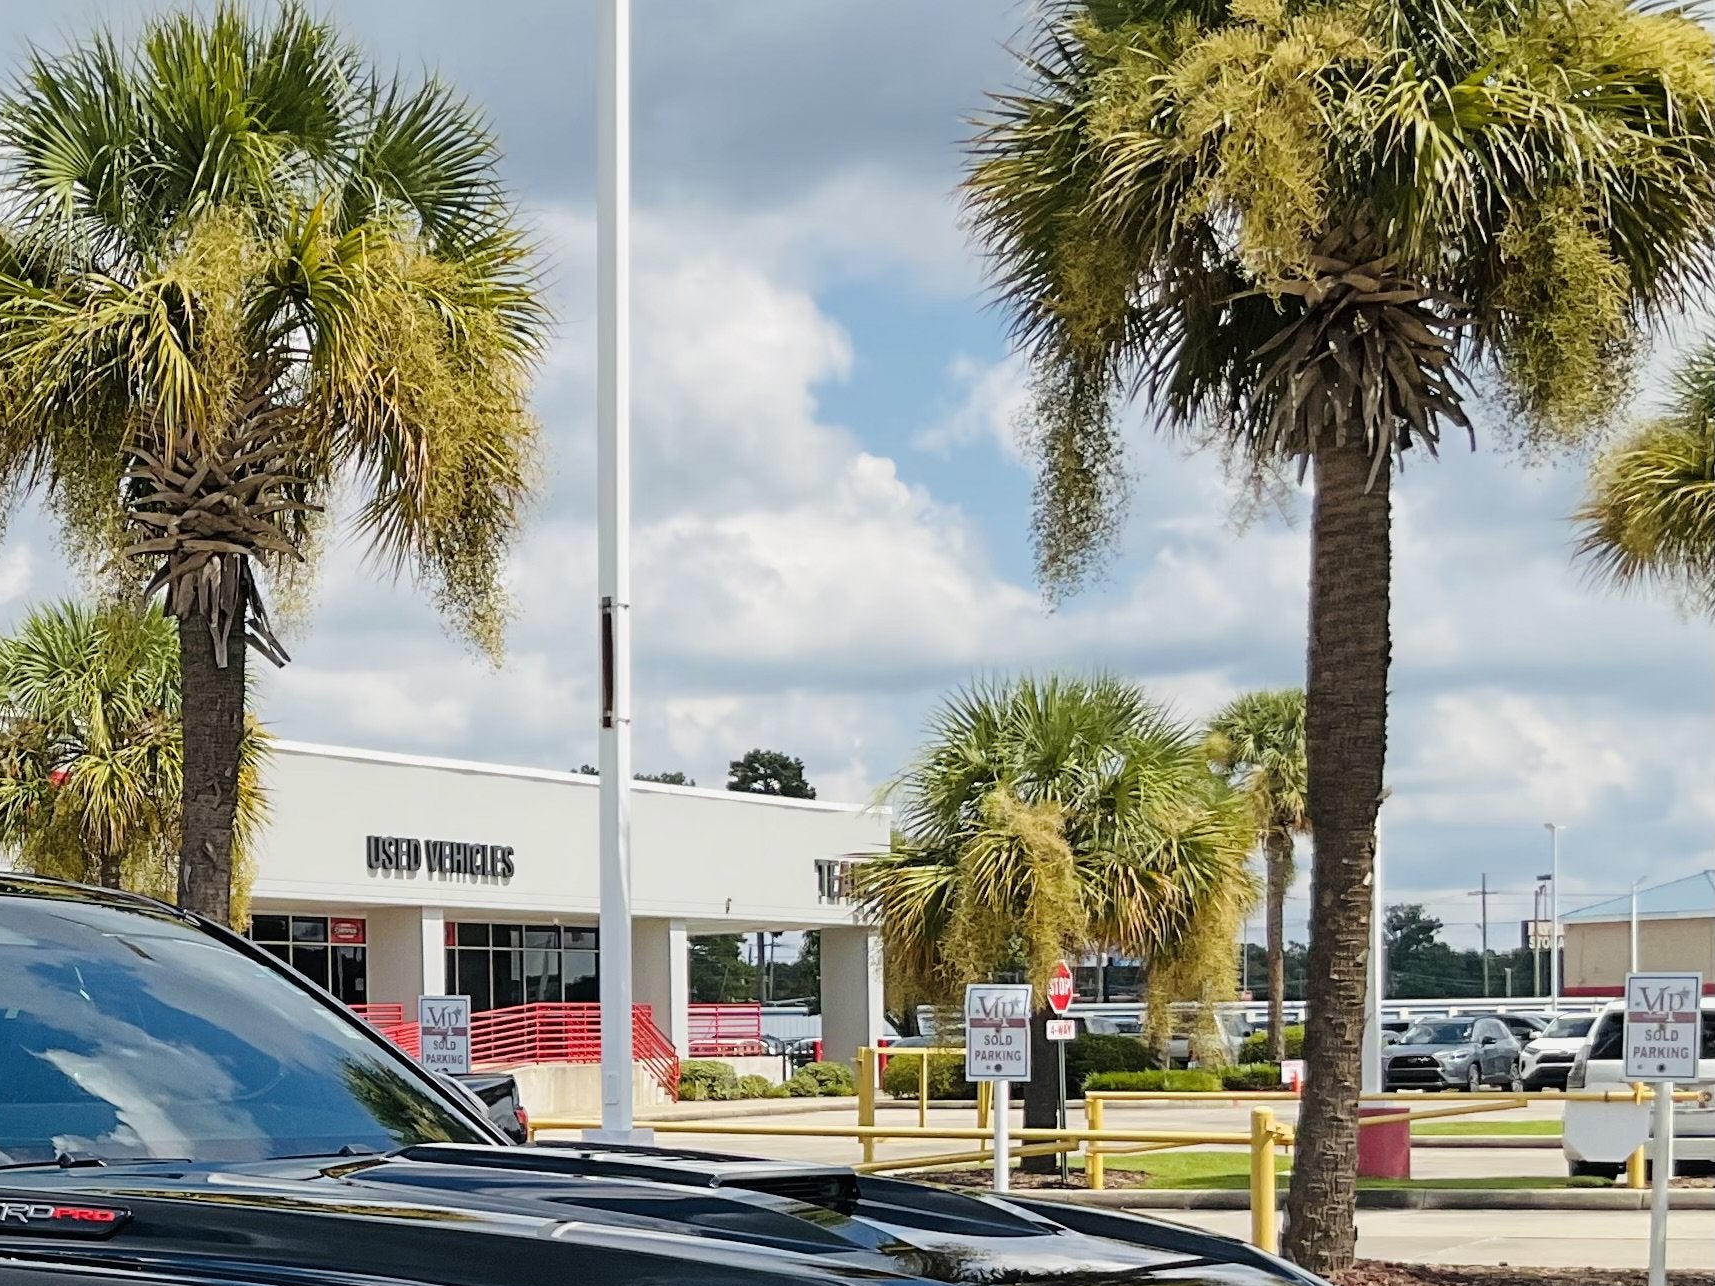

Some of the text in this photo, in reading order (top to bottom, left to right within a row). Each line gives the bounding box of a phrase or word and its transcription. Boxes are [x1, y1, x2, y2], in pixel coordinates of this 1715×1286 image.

[366, 835, 515, 878] USED VEHICLES
[1047, 976, 1071, 996] STOP
[1050, 1024, 1072, 1036] 4-WAY
[1645, 1029, 1679, 1041] SOLD
[433, 1040, 456, 1050] SOLD
[984, 1034, 1013, 1046] SOLD
[974, 1050, 1022, 1061] PARKING
[1633, 1046, 1689, 1059] PARKING
[426, 1054, 463, 1064] PARKING
[53, 1206, 115, 1223] PRO
